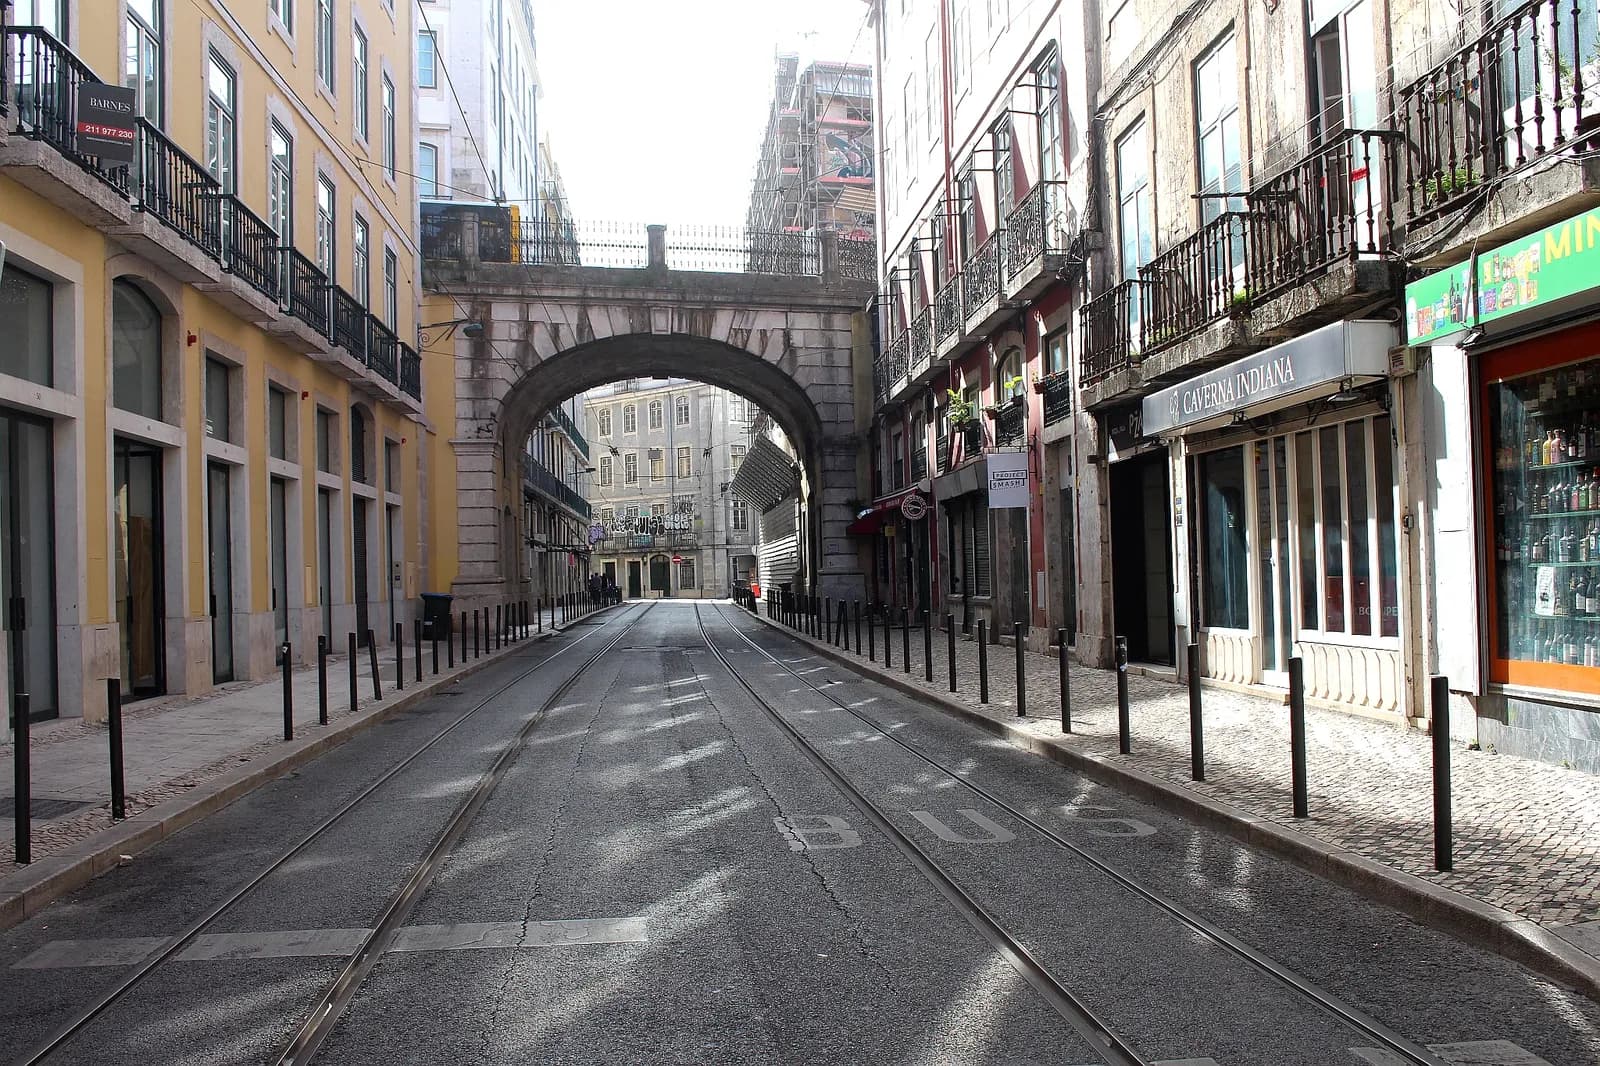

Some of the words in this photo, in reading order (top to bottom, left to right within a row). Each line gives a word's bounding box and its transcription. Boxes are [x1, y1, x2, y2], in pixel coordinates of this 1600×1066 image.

[90, 97, 131, 112] BARNES
[85, 125, 99, 134] 211
[102, 127, 117, 136] 977
[118, 130, 133, 139] 230
[1183, 377, 1235, 415] CAVERNA
[1236, 355, 1295, 399] INDIANA
[774, 807, 1158, 852] BUS
